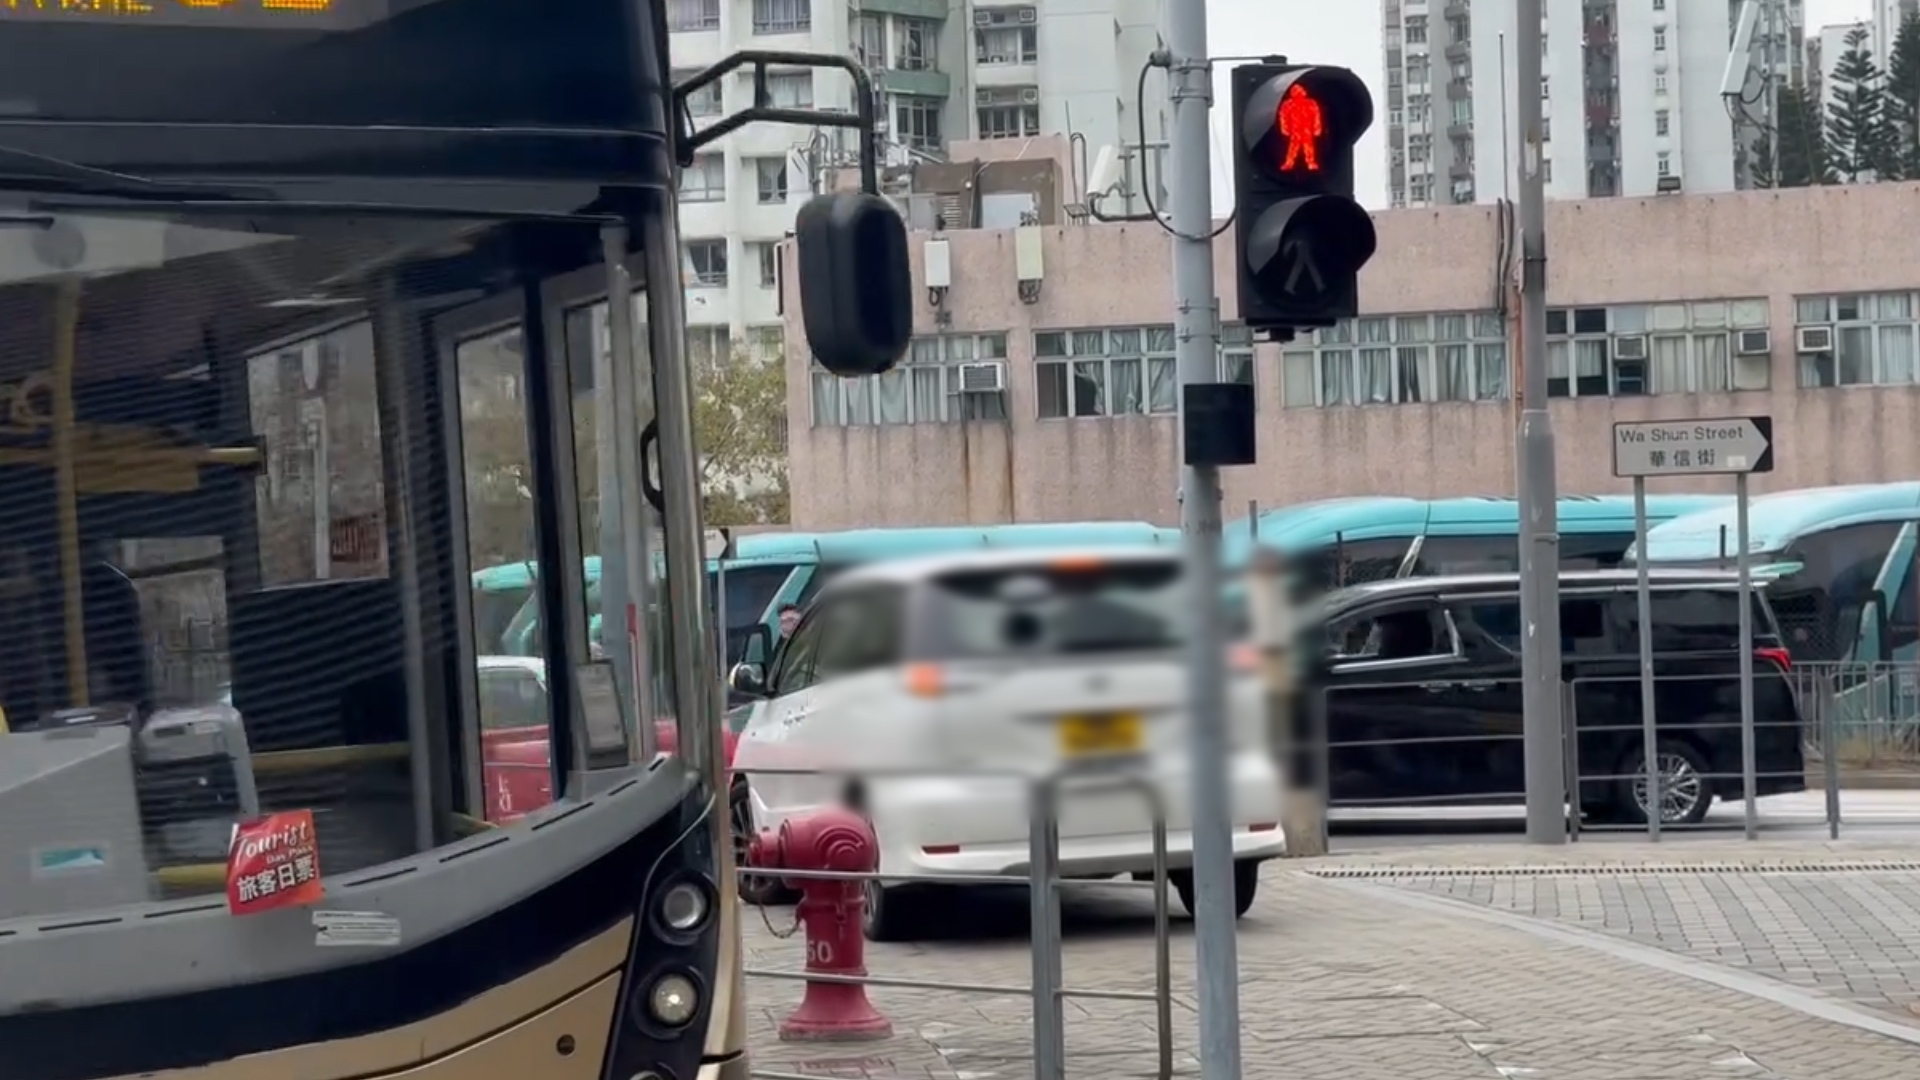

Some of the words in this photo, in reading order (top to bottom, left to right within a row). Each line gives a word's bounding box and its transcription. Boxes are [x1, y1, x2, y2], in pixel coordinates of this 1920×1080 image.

[1619, 429, 1645, 443] Wa
[1651, 428, 1689, 442] Shun
[1694, 426, 1743, 441] Street
[1650, 449, 1715, 467] 華信街
[230, 821, 308, 867] Tourist
[237, 854, 314, 902] 旅客日票
